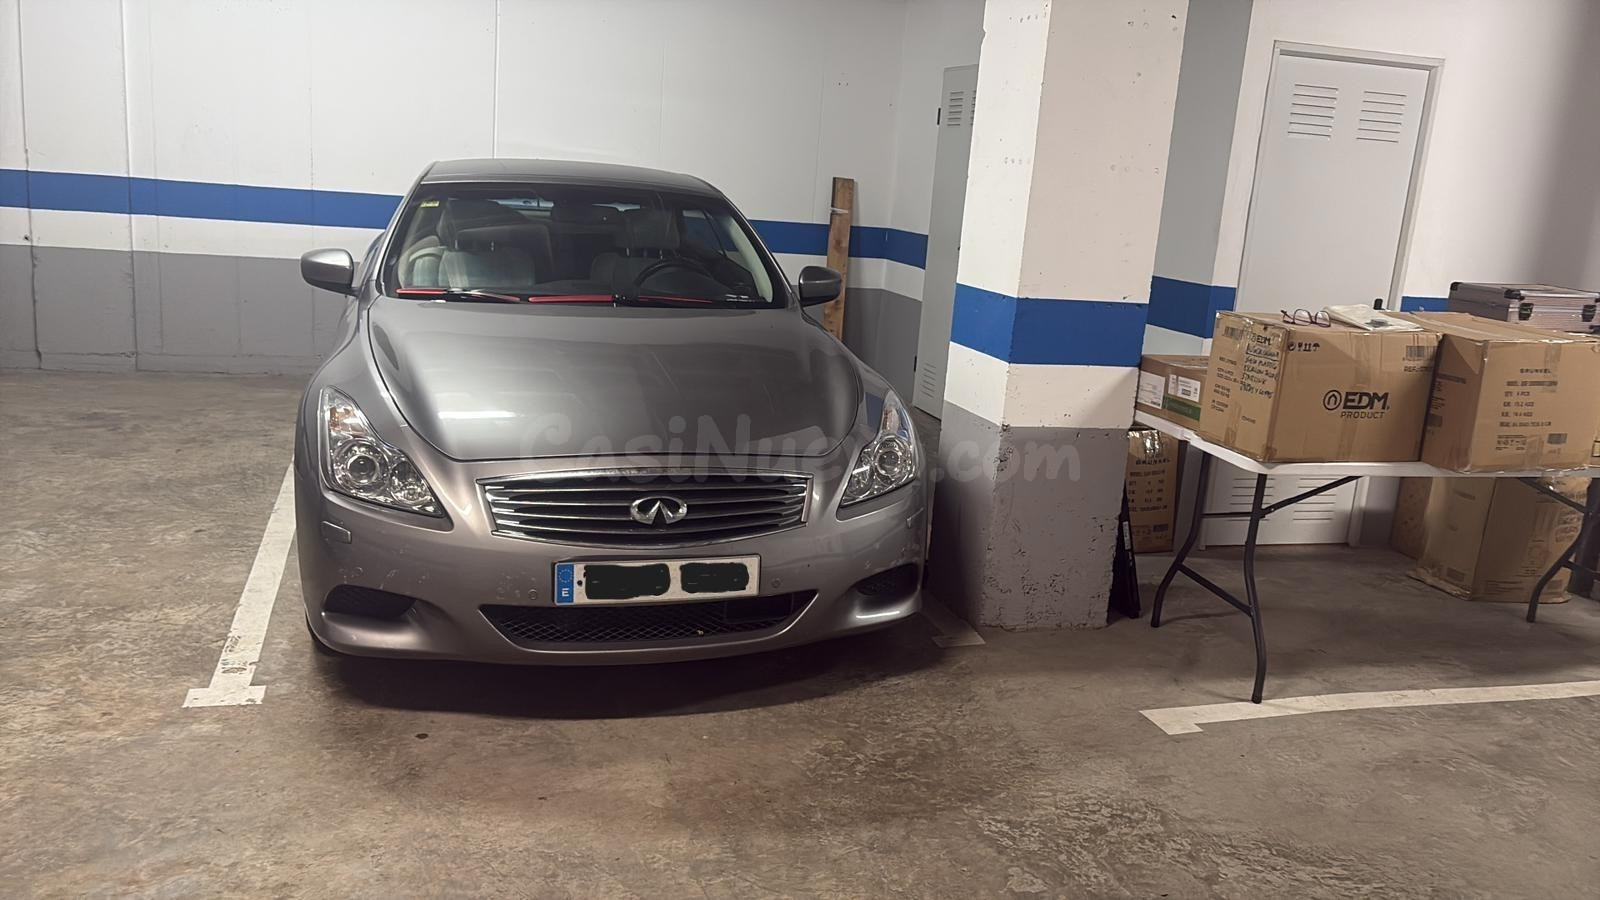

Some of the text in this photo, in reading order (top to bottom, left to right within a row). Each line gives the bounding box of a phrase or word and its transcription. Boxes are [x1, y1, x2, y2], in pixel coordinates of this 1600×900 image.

[1342, 391, 1388, 410] EDM
[1340, 411, 1385, 419] PRODUCT
[561, 588, 569, 597] E
